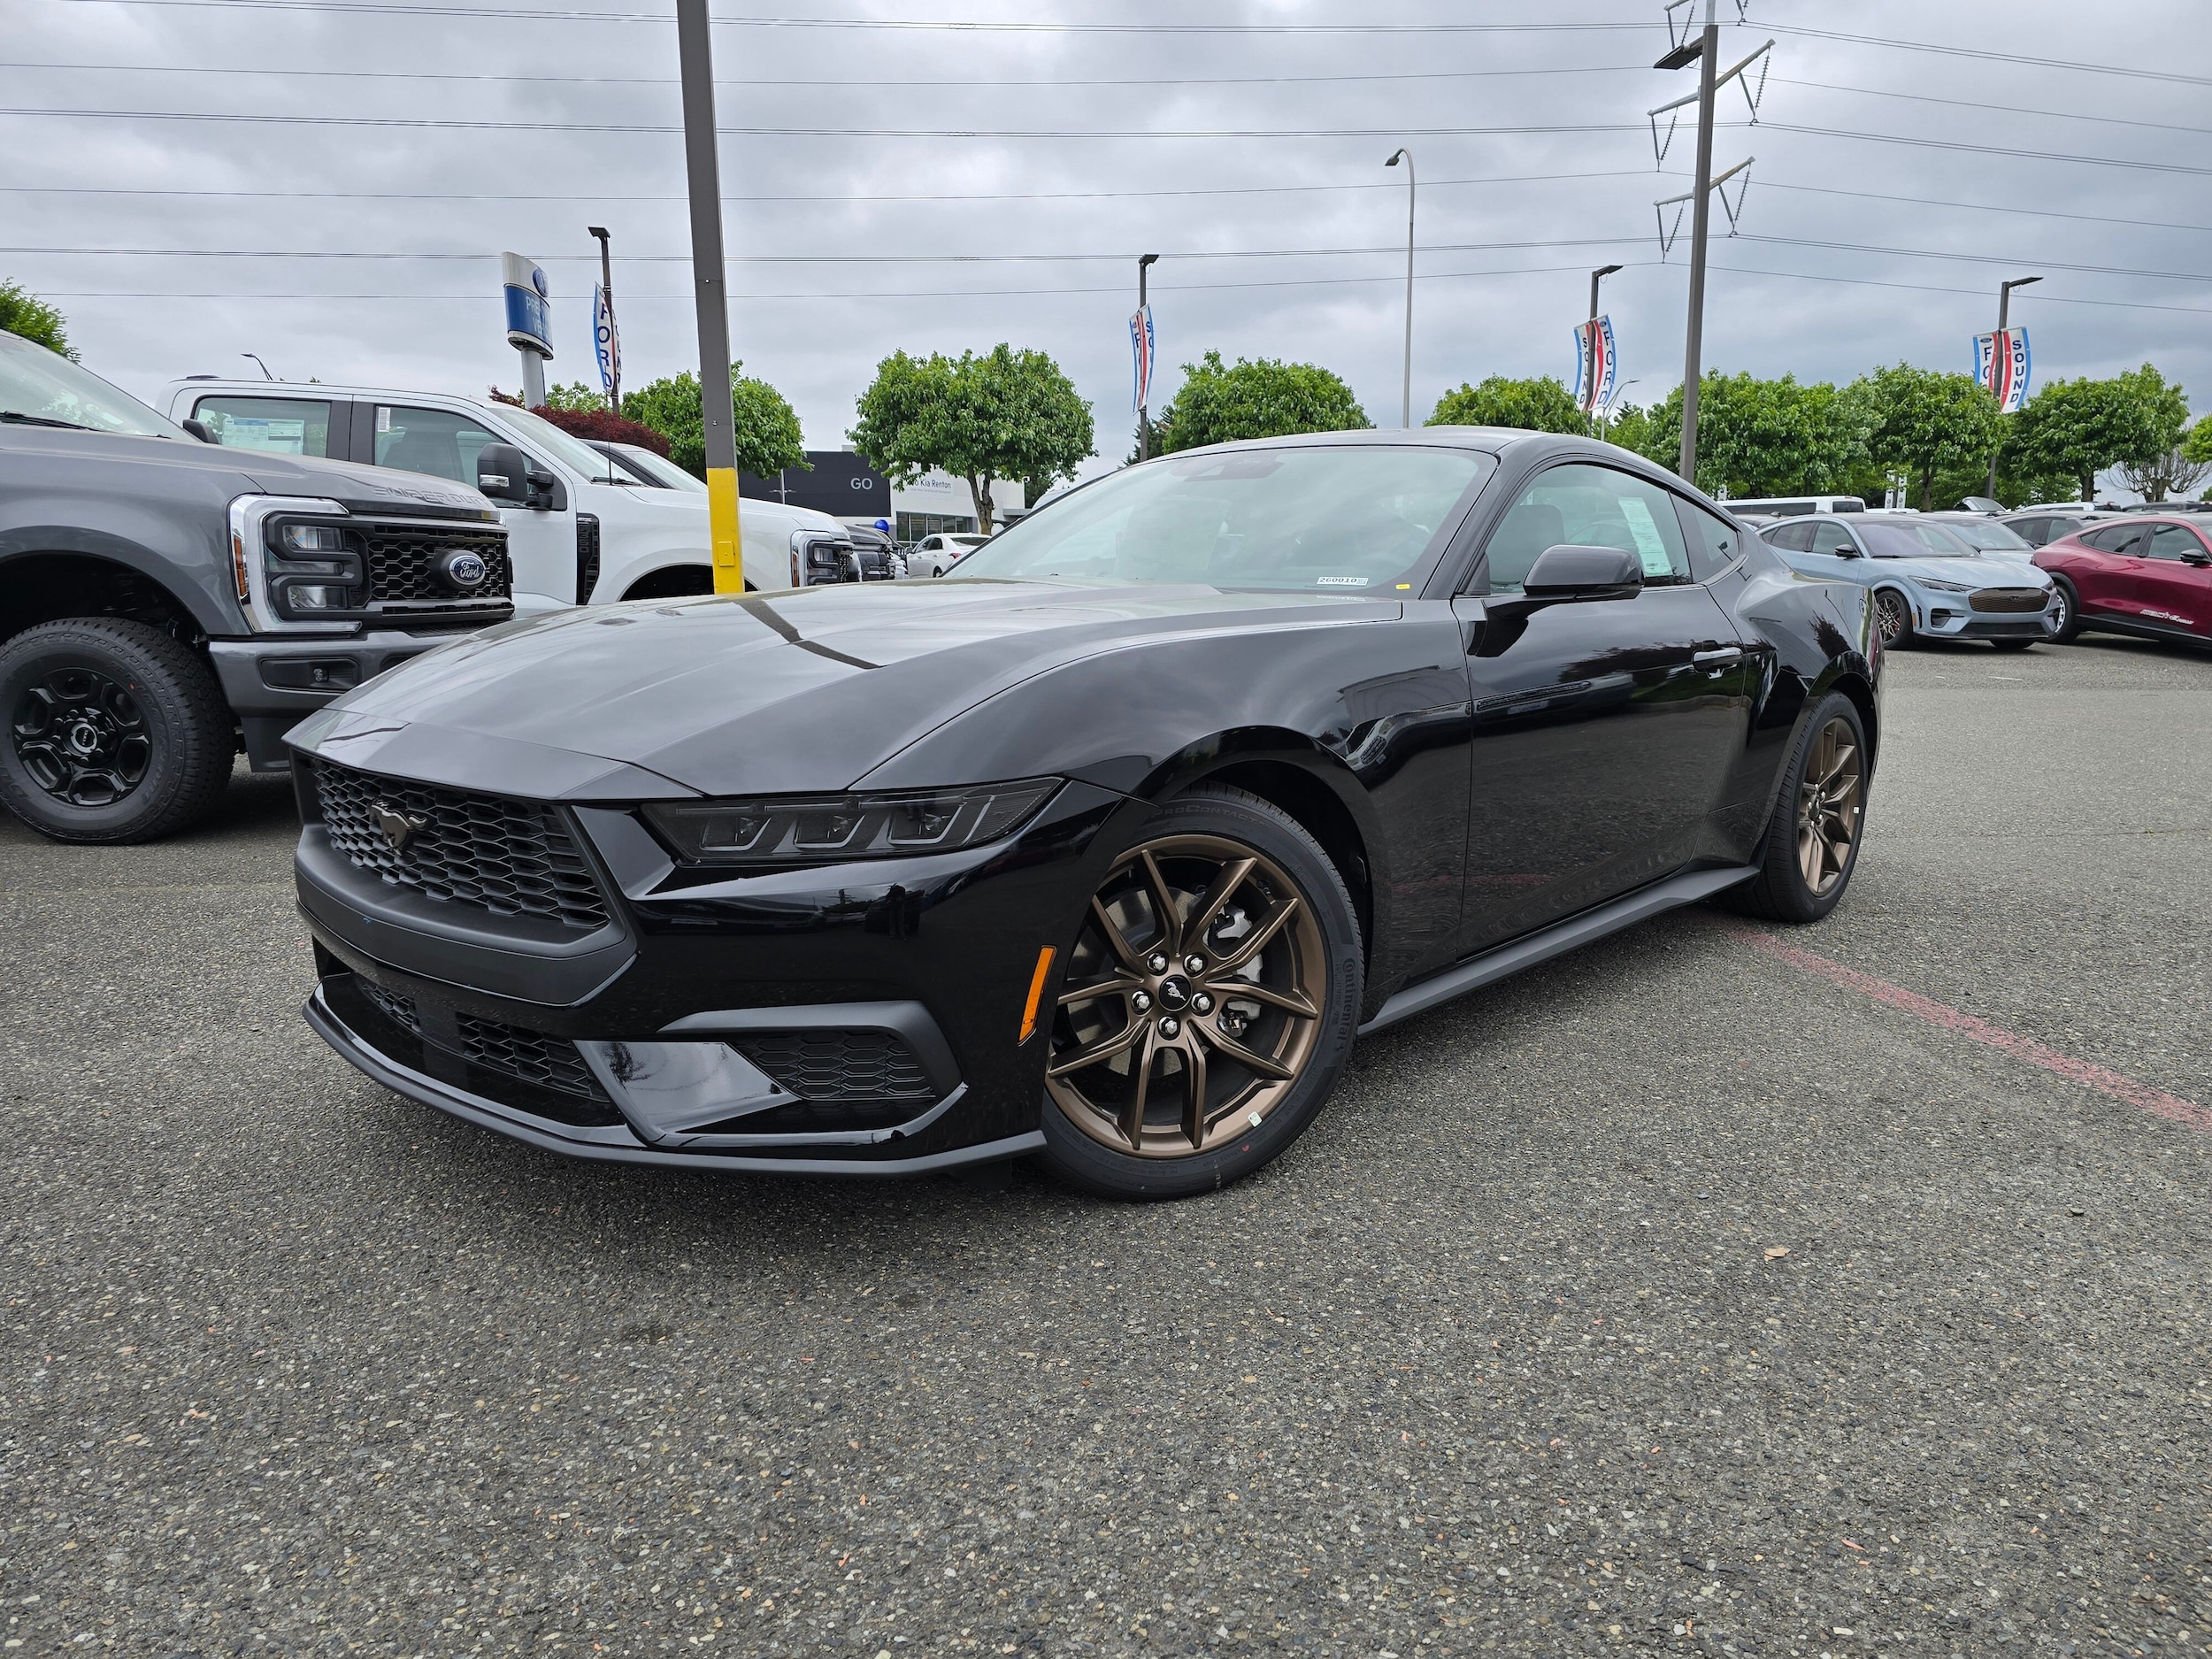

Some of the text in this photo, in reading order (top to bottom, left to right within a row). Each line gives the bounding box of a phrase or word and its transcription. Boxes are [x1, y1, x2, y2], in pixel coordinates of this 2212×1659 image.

[597, 303, 612, 388] FORD
[1597, 331, 1613, 404] FORD
[2009, 340, 2024, 403] SOUND
[374, 487, 449, 504] SUPER
[850, 478, 872, 489] GO
[932, 480, 951, 488] Renton
[459, 560, 480, 578] Ford
[1337, 957, 1356, 1041] Continental
